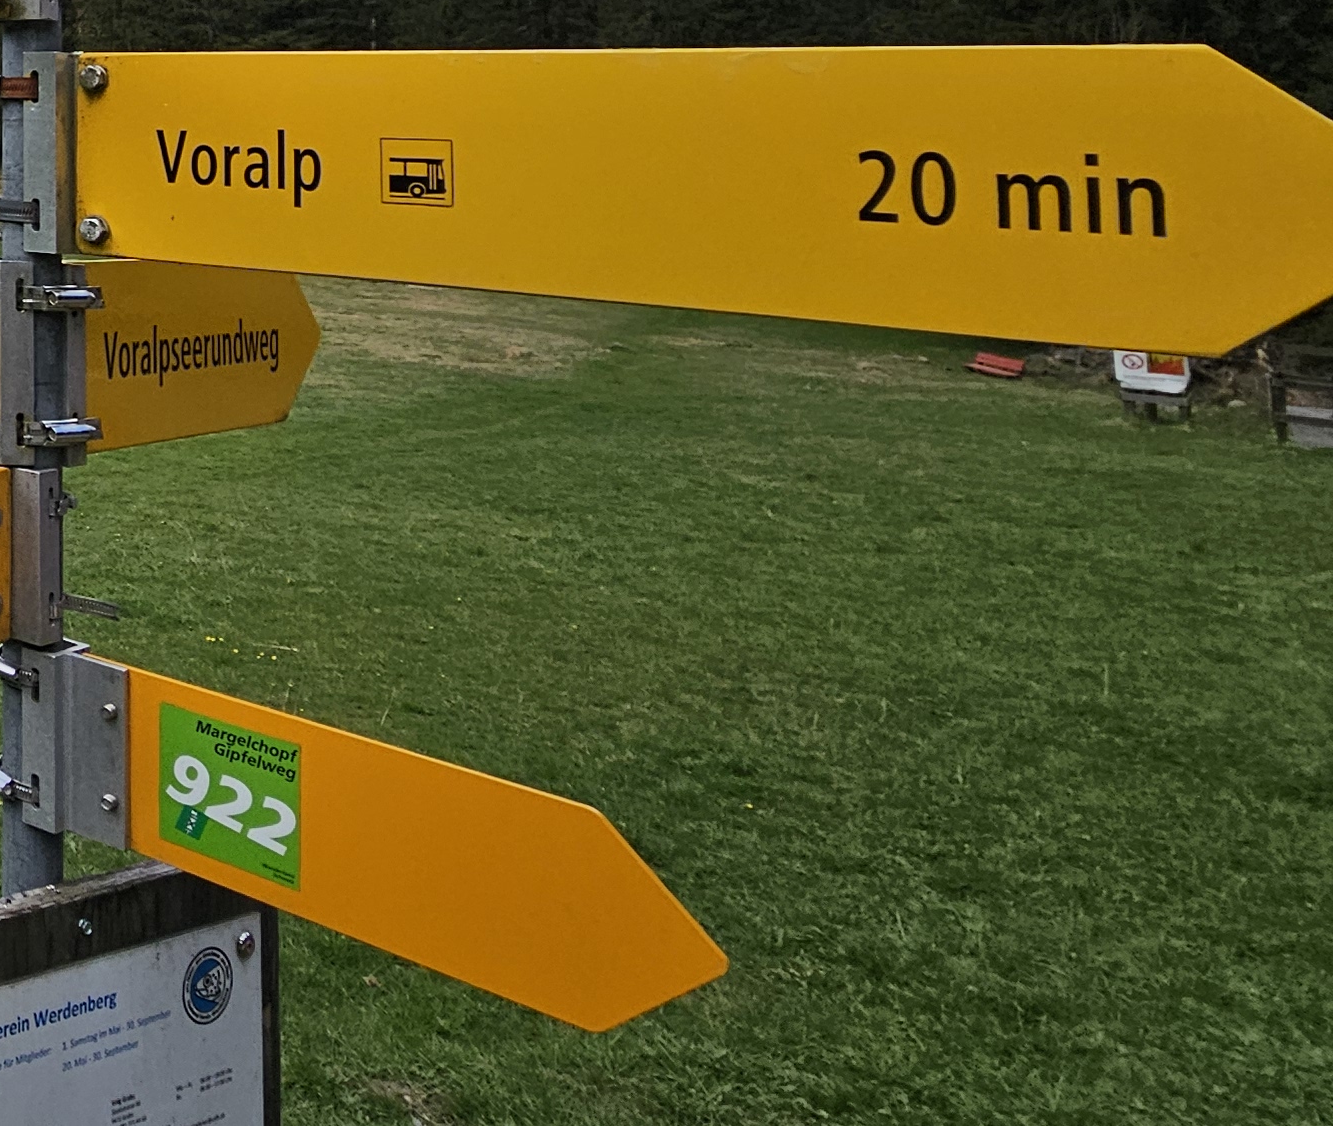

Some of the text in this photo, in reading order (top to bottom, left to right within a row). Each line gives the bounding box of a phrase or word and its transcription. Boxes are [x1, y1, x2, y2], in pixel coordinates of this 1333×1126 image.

[155, 129, 322, 208] Voralp
[858, 150, 1168, 238] 20 min
[103, 318, 279, 388] Voralpseerundweg
[196, 720, 299, 763] Margelchopf
[214, 743, 296, 783] Gipfelweg
[165, 755, 297, 856] 922
[33, 992, 117, 1028] Werdenberg
